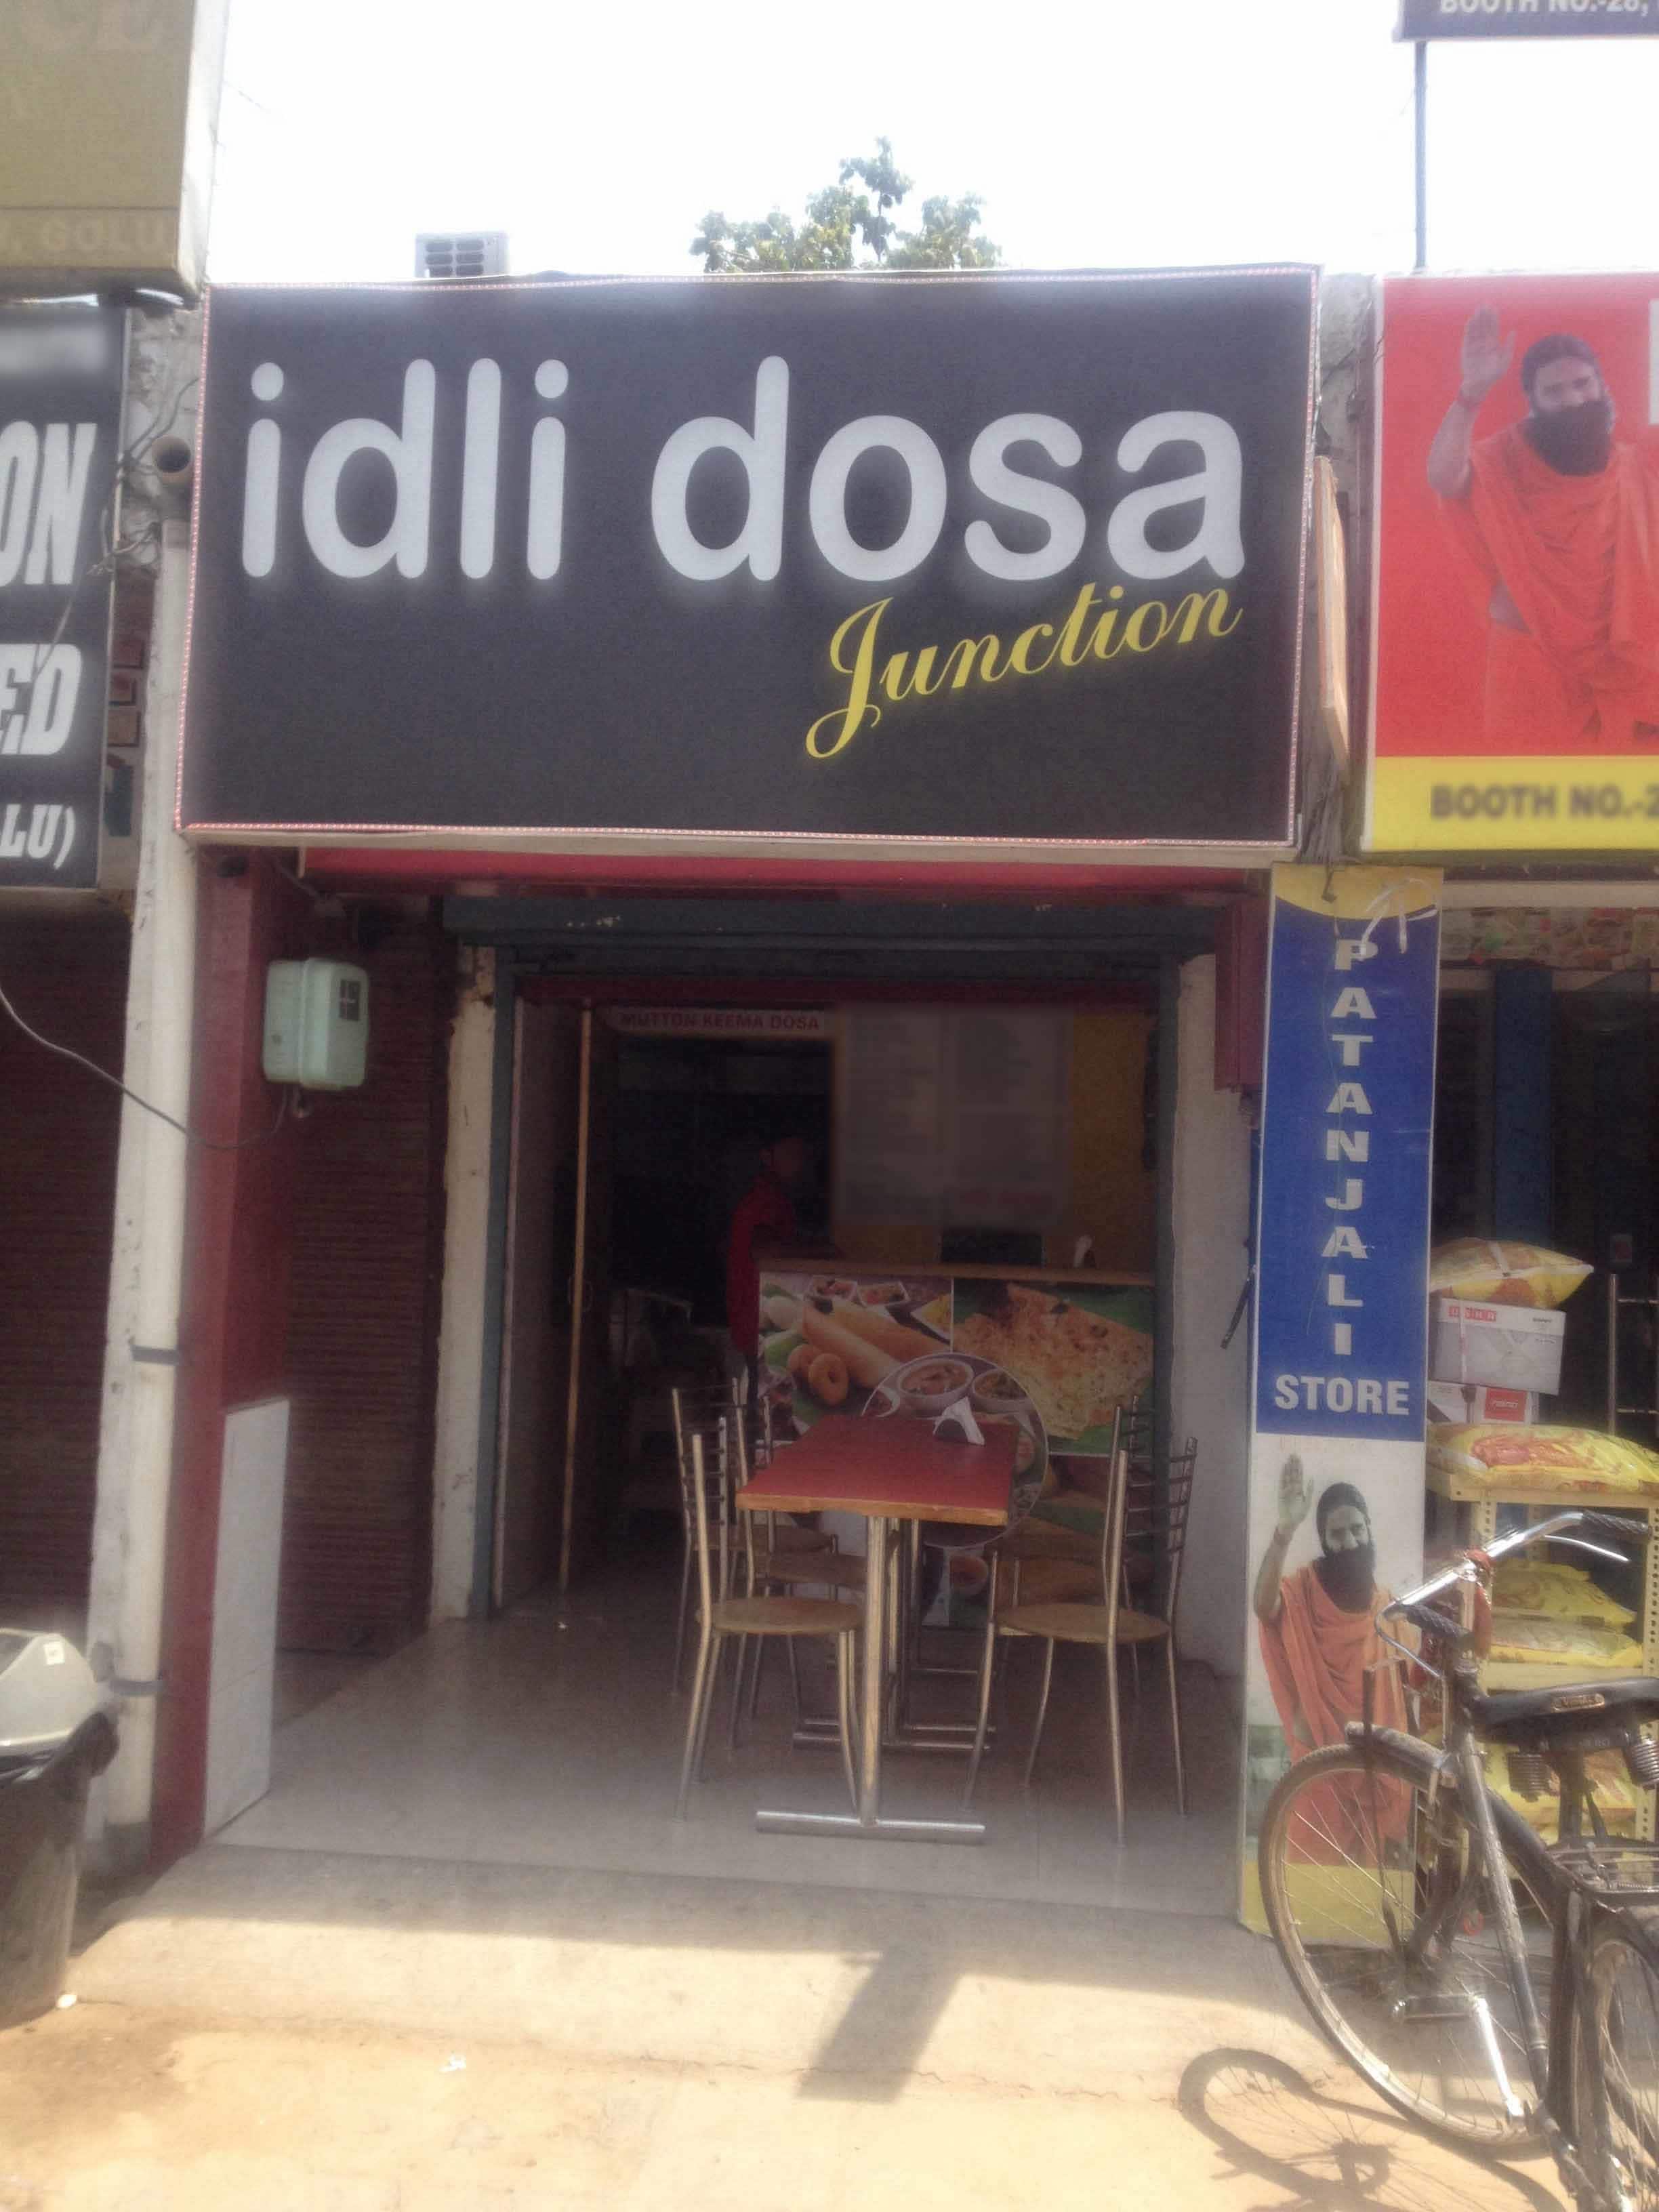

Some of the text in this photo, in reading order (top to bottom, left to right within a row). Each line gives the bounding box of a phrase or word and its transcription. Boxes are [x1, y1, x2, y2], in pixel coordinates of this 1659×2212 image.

[242, 355, 1246, 581] idli dosa
[805, 581, 1244, 758] Junction
[1430, 783, 1557, 819] BOOTH
[770, 1015, 819, 1030] DOSA
[1322, 939, 1379, 1356] PATANJALI
[1275, 1374, 1410, 1415] STORE
